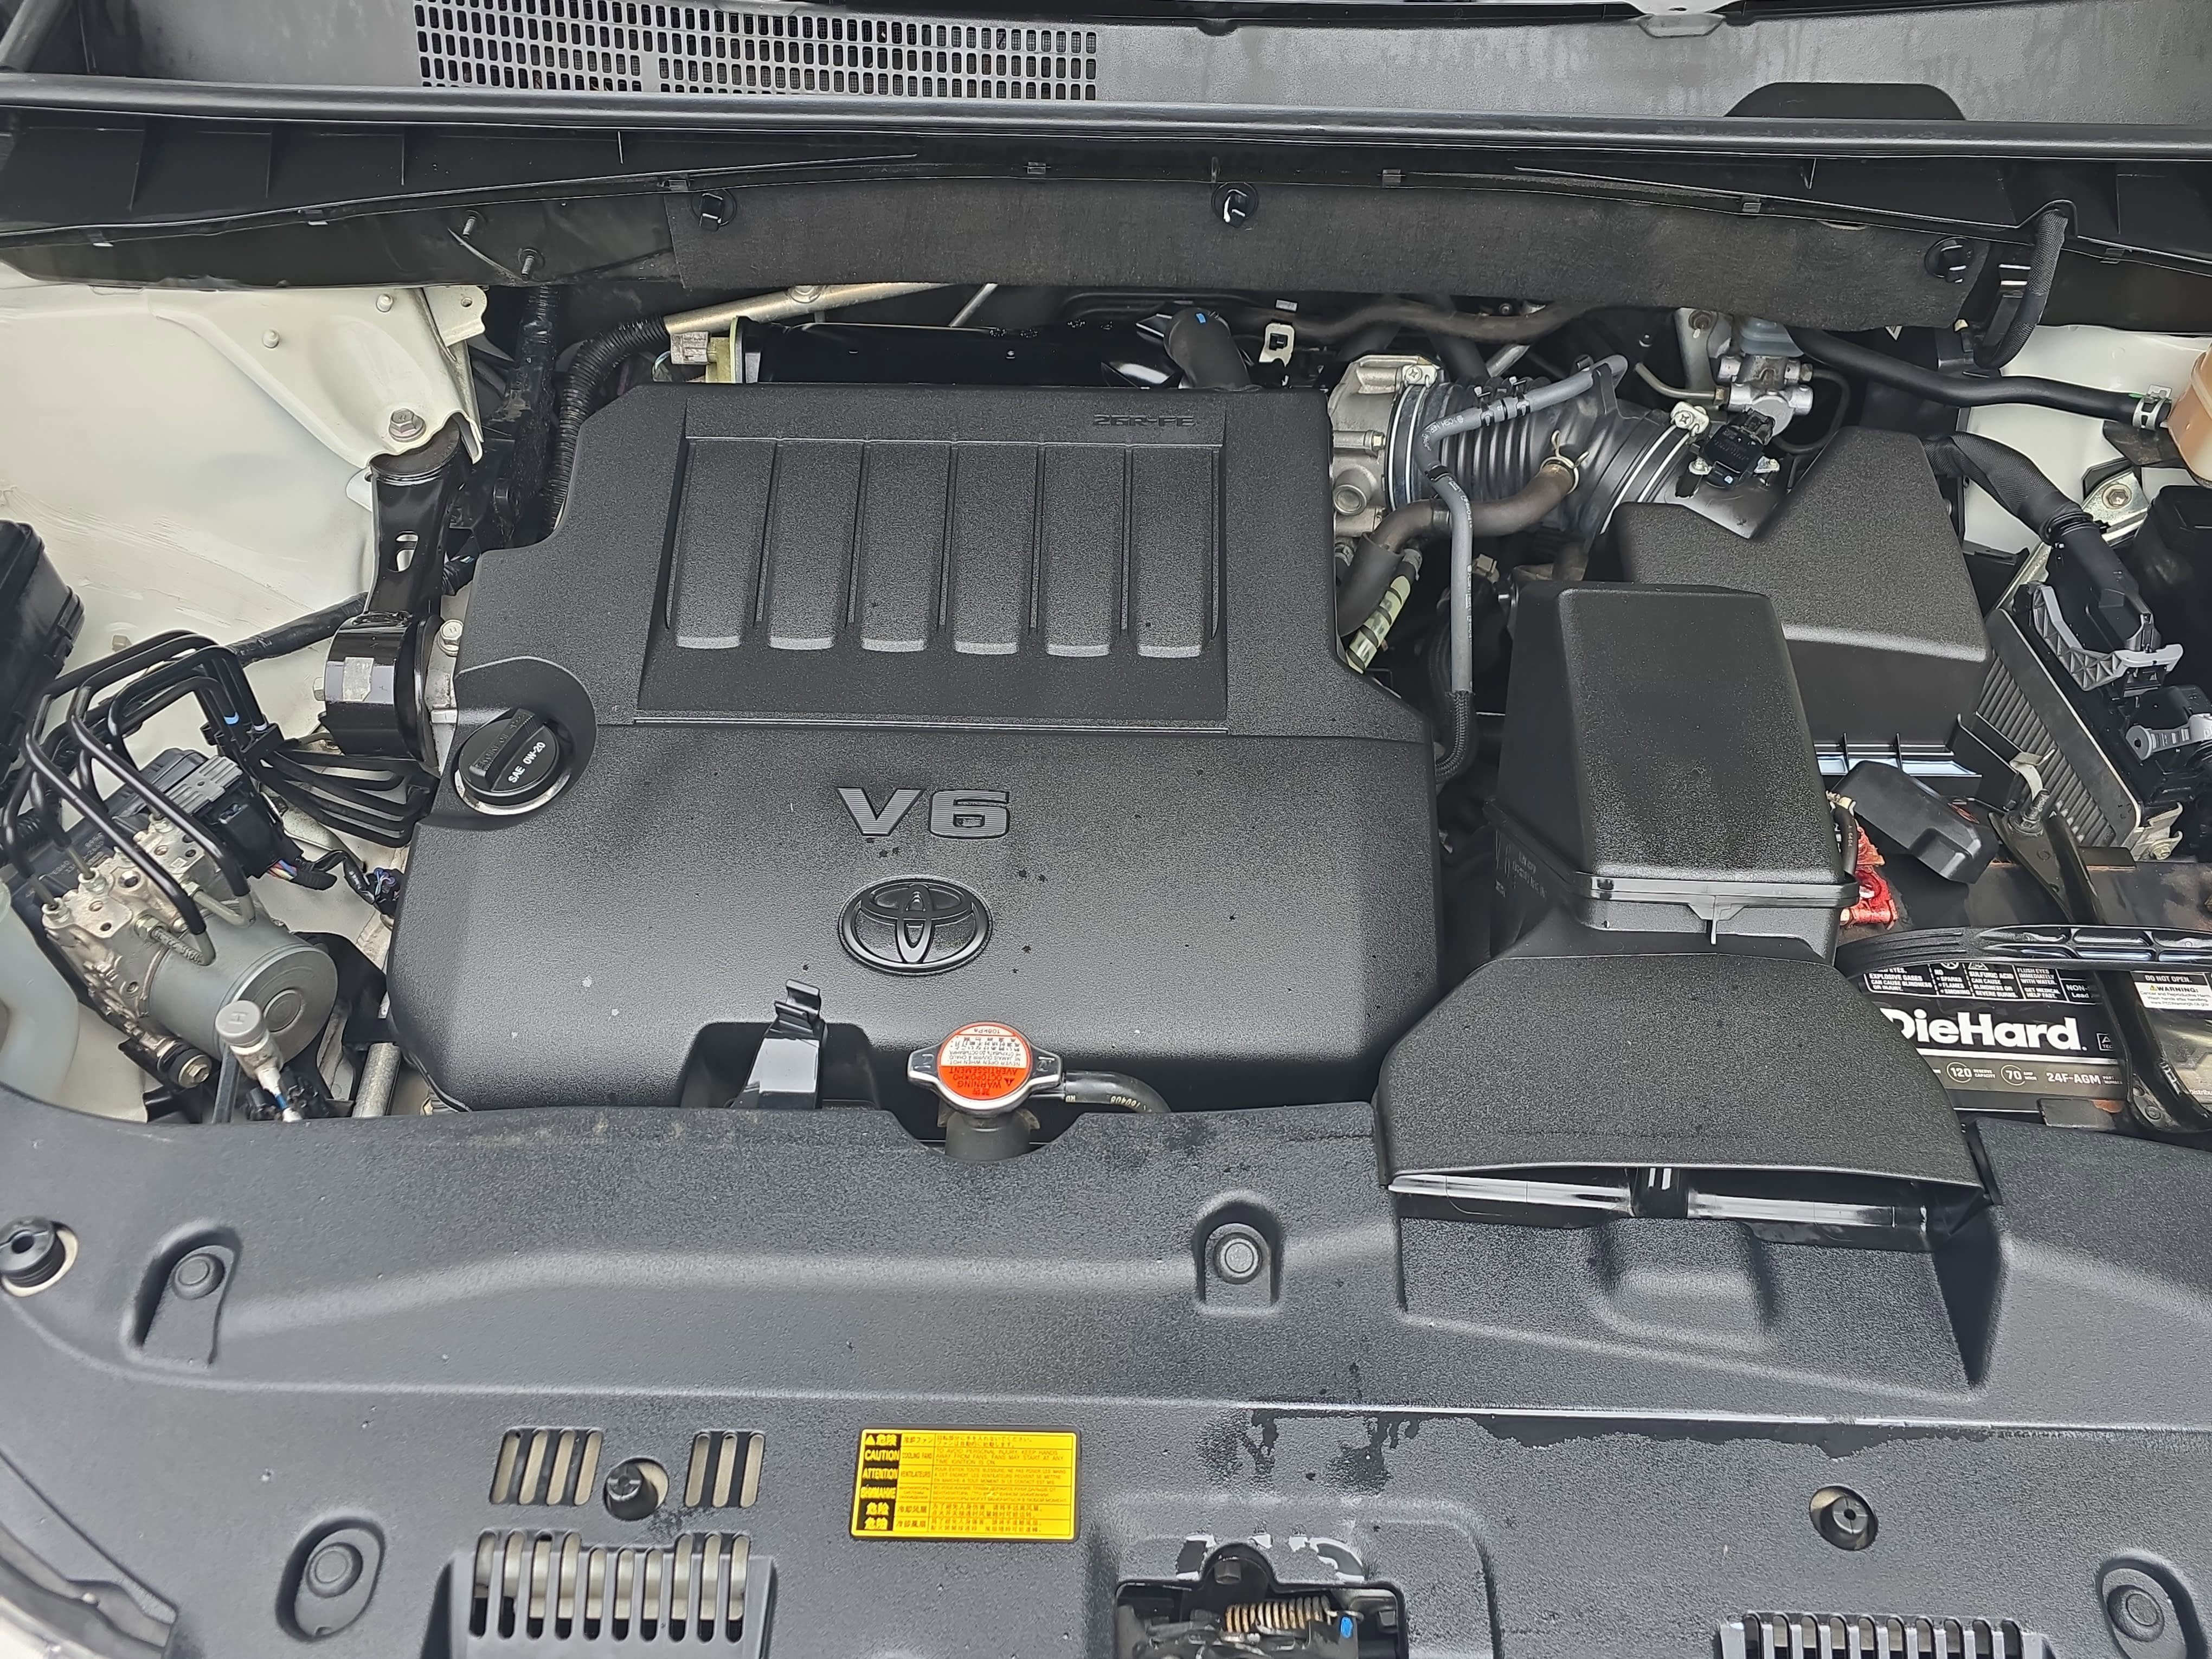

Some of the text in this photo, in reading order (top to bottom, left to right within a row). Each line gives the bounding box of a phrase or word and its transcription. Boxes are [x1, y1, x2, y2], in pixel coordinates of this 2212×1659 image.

[1093, 414, 1196, 427] 2GR-FE
[508, 742, 546, 783] SAE 0W-20
[837, 787, 1011, 840] V6
[949, 1067, 1018, 1076] AVERTISSEMENT
[1950, 1067, 1972, 1078] 120
[2005, 1070, 2022, 1080] 70
[957, 1080, 1001, 1088] WARNING
[2046, 1072, 2101, 1084] 24F-AGM
[865, 1449, 899, 1461] CAUTION
[863, 1468, 898, 1480] ATTENTION
